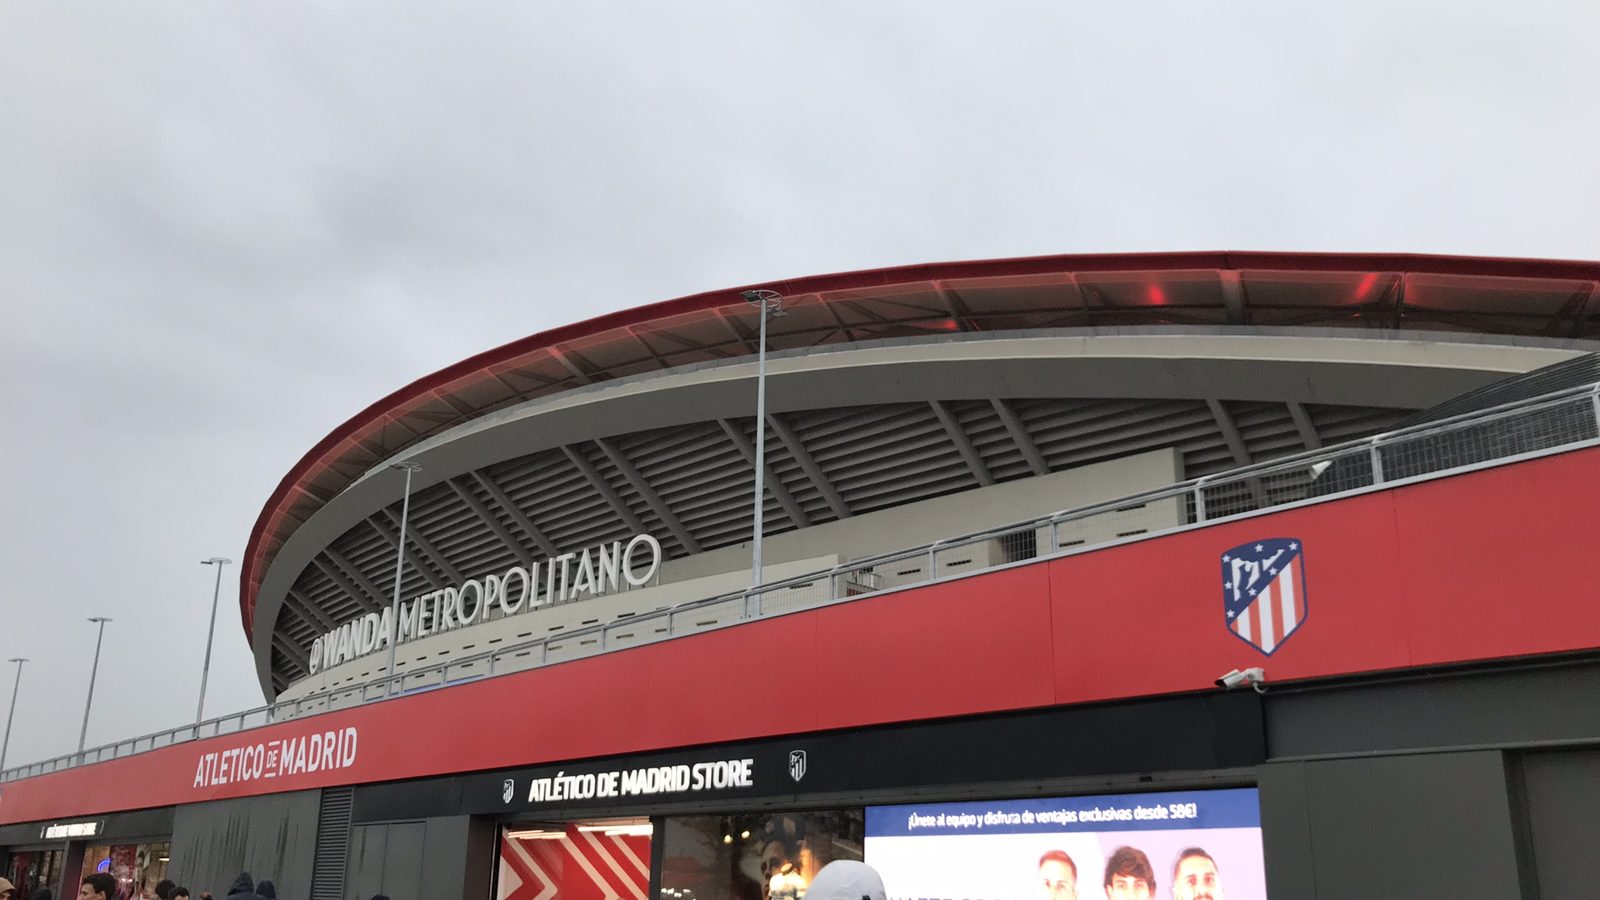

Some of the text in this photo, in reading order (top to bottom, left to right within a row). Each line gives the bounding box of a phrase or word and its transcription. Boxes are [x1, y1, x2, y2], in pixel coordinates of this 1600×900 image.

[323, 534, 661, 669] WANDA METROPOLITANO
[193, 727, 358, 788] ATLETICO DE MADRID
[528, 759, 754, 803] ATLÉTICO DE MADRID STORE
[937, 813, 945, 826] al
[946, 813, 976, 828] equipo
[976, 815, 983, 828] y
[984, 811, 1020, 825] disfruta
[1021, 810, 1035, 824] de
[1035, 809, 1077, 826] ventajas
[1079, 807, 1133, 822] exclusivas
[1133, 804, 1169, 820] desde
